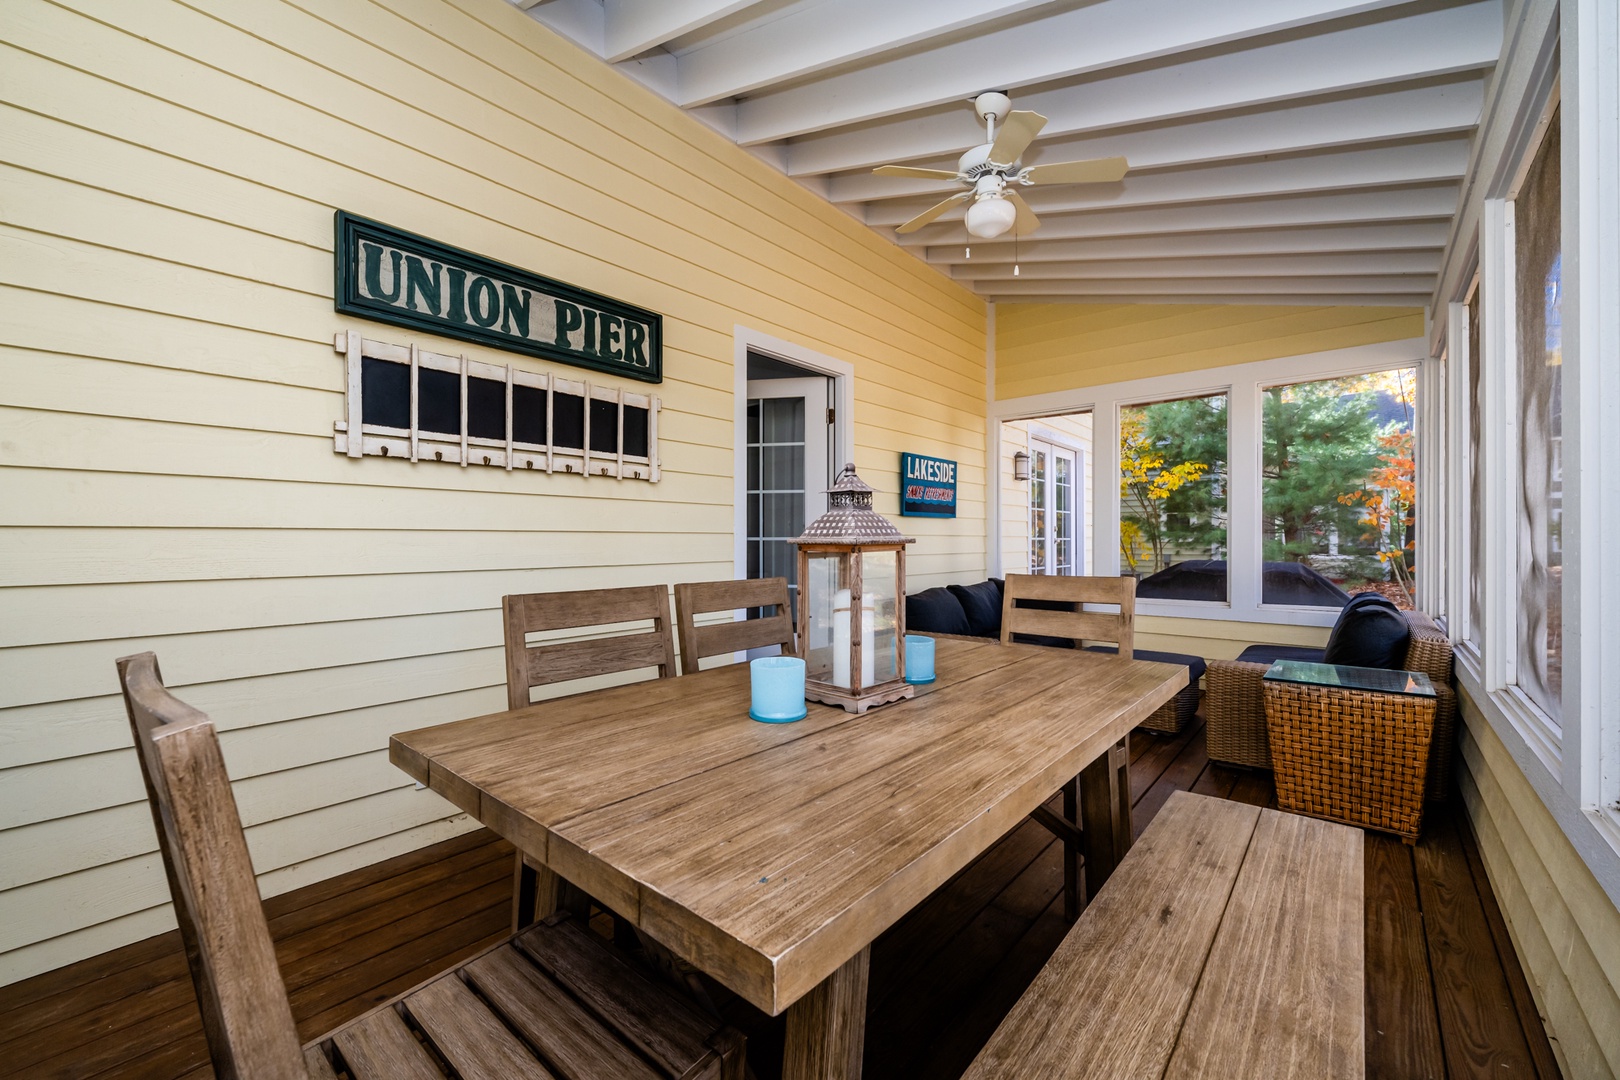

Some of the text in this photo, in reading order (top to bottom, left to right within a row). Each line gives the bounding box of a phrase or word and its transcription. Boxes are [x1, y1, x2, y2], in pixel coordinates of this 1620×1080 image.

[363, 243, 648, 366] UNION PIER
[907, 457, 955, 483] LAKESIDE
